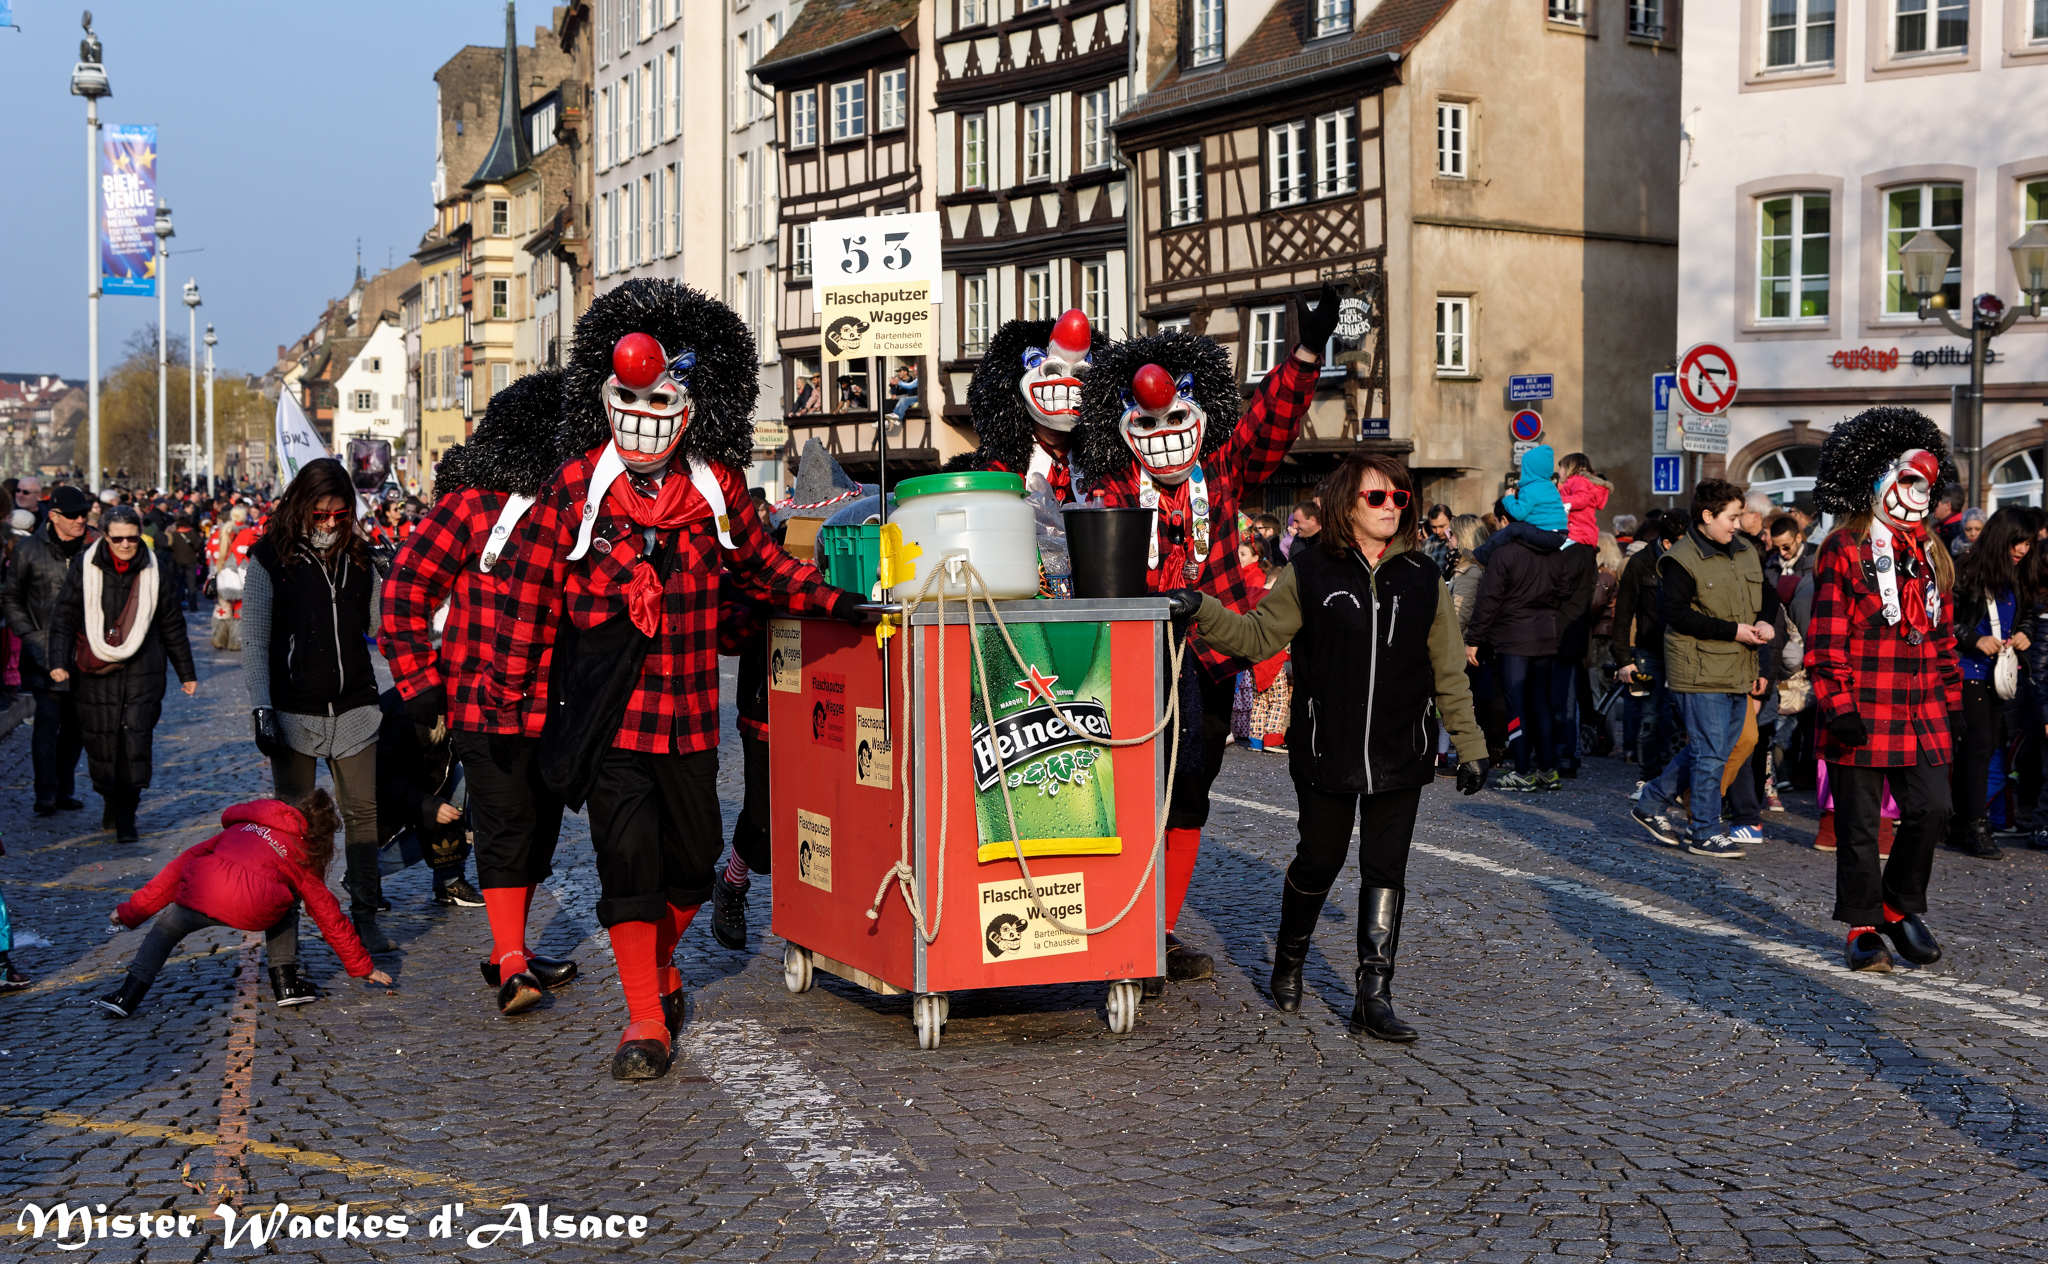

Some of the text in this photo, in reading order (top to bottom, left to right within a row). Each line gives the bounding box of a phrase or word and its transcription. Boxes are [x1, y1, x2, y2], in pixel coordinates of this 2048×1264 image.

[103, 173, 145, 193] BIEN-
[104, 189, 155, 209] VENUE
[841, 232, 912, 274] 53
[825, 289, 928, 305] Flaschaputzer
[869, 310, 928, 325] Wagges
[876, 331, 922, 340] Bartenheim
[873, 341, 923, 350] la Chaussée
[1832, 346, 1899, 372] cuisine
[1684, 435, 1706, 443] DESSERTE
[771, 625, 801, 641] Flaschaputzer
[783, 645, 801, 661] Wagges
[812, 676, 845, 694] Flaschaputzer
[825, 699, 845, 717] Wagges
[1000, 697, 1024, 710] MARQUE
[857, 714, 885, 732] Flaschaput
[871, 737, 892, 754] Wagges
[973, 709, 1112, 775] Heineken
[799, 815, 831, 837] Flaschaputzer
[811, 839, 831, 858] Wagges
[433, 854, 462, 864] adidas
[982, 882, 1082, 904] Flaschaputzer
[1033, 937, 1080, 950] la Chaussée
